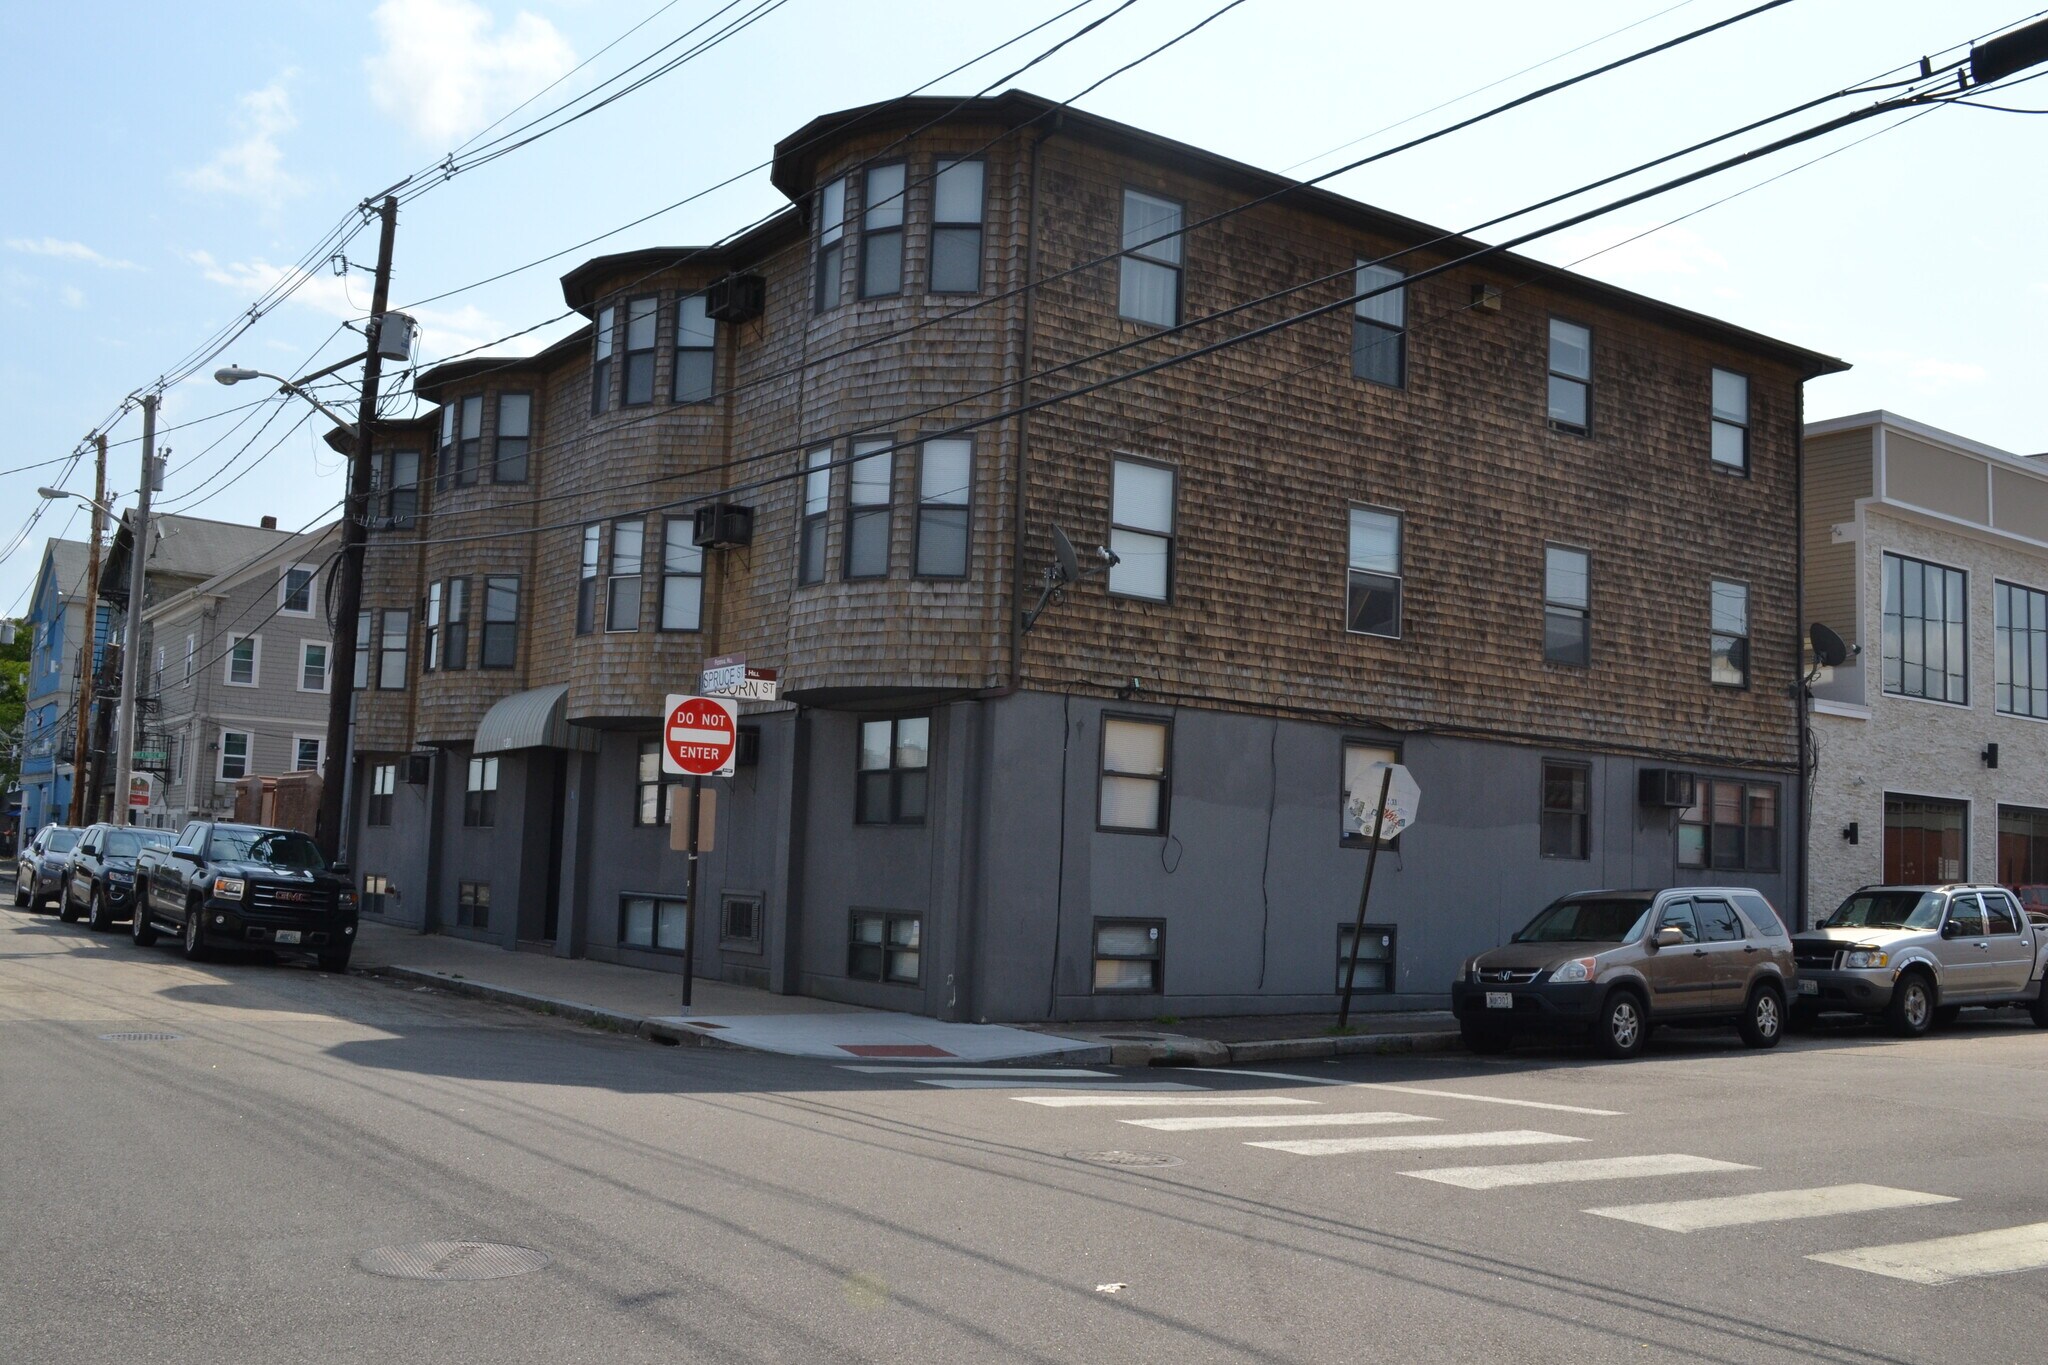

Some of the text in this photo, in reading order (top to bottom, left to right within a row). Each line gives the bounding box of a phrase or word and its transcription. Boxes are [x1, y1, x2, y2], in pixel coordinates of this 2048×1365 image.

[703, 666, 745, 689] SPRUCE ST
[748, 669, 760, 677] HILL
[762, 682, 775, 694] ST
[677, 711, 726, 727] DO NOT
[680, 745, 719, 760] ENTER
[275, 890, 311, 902] GMC
